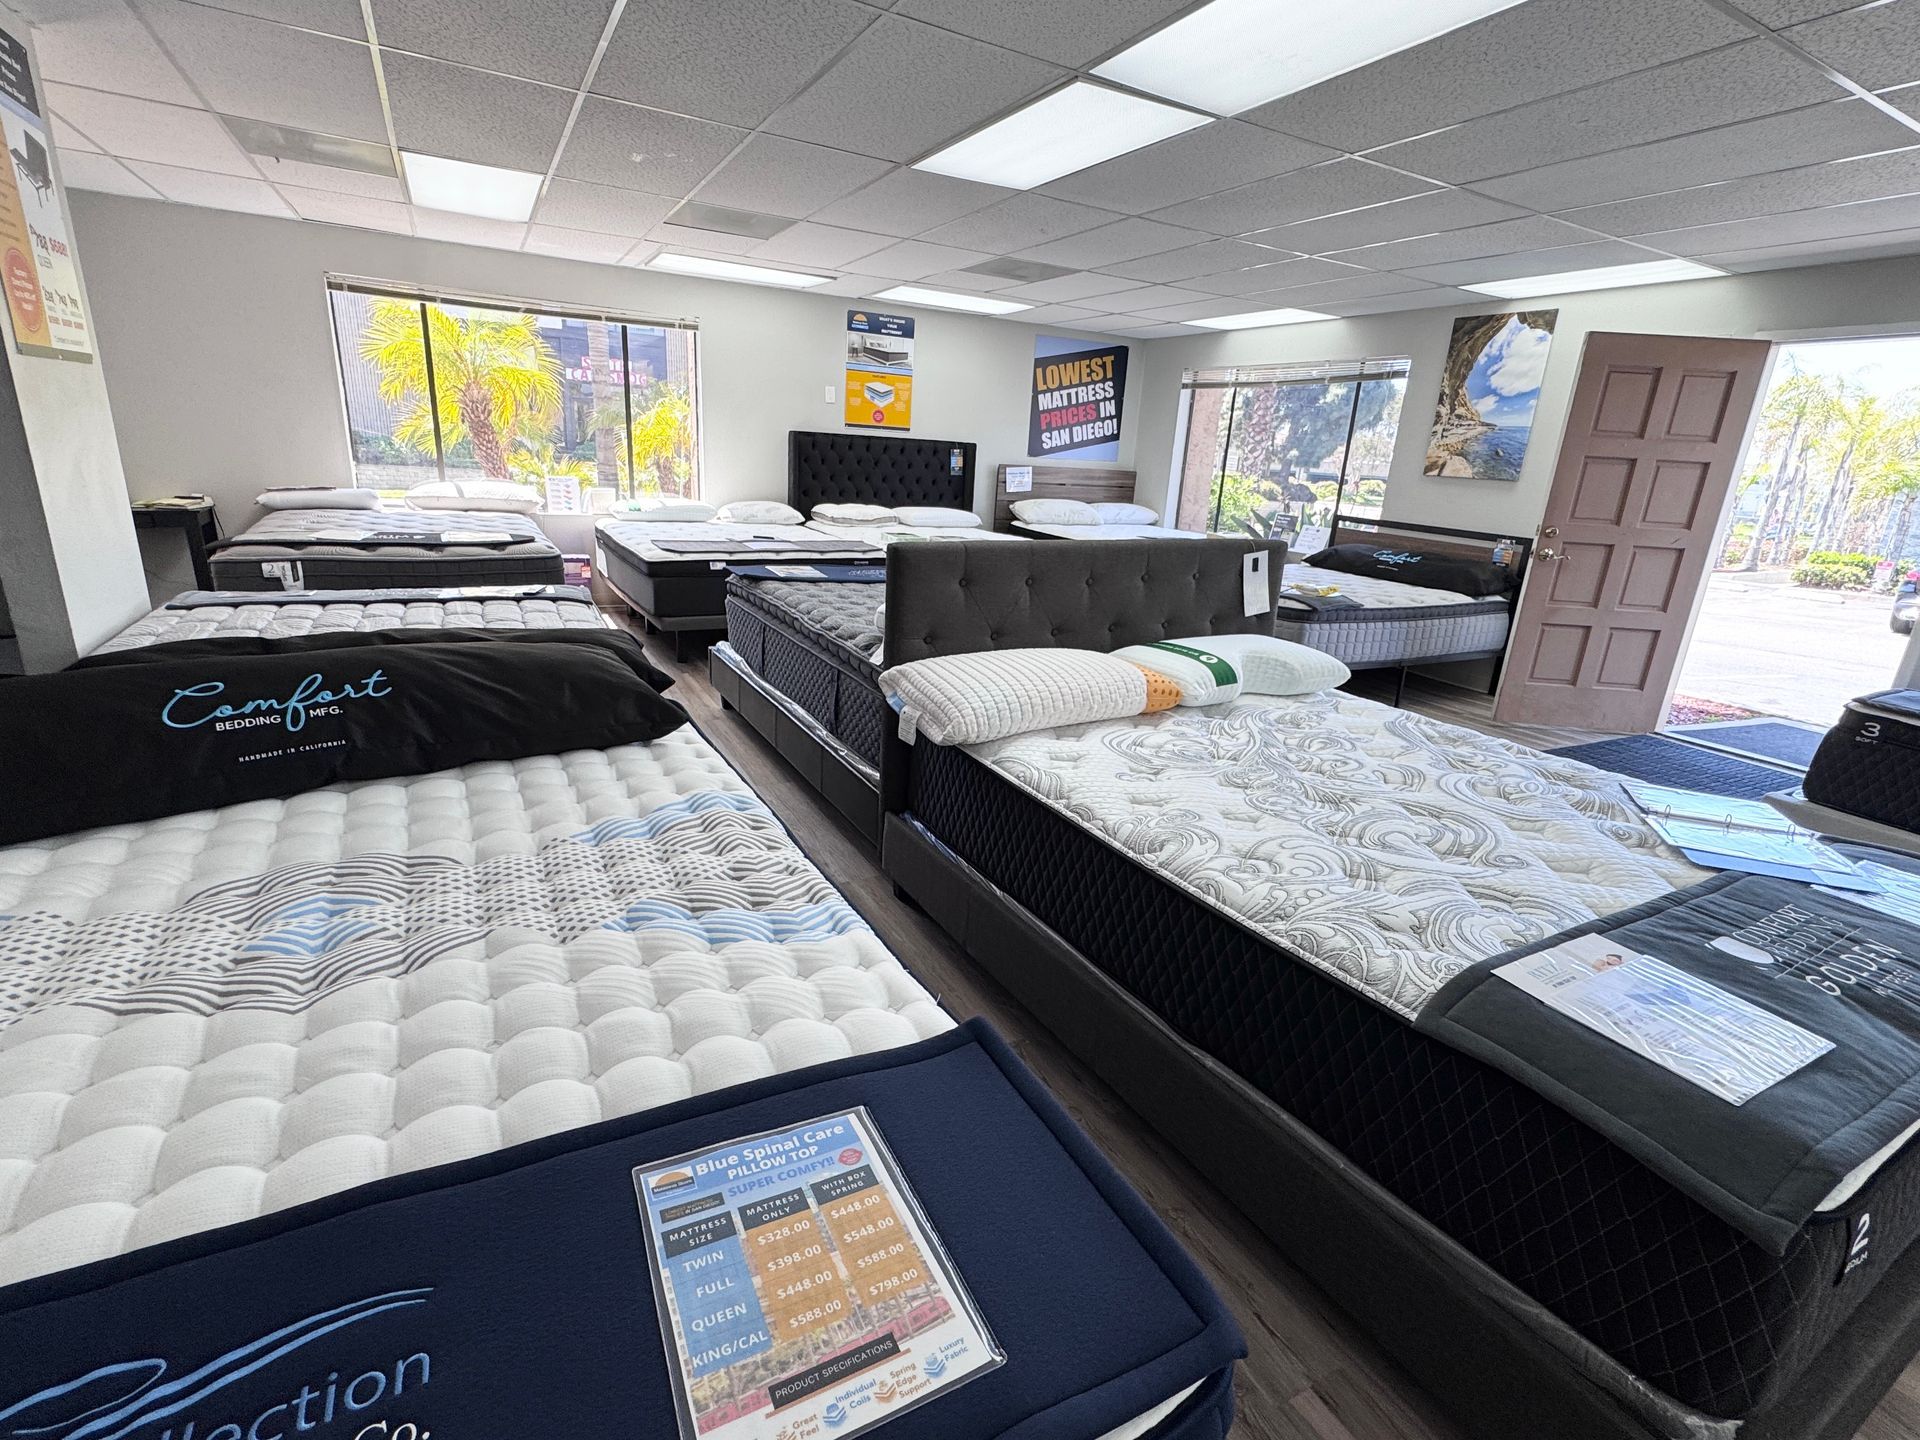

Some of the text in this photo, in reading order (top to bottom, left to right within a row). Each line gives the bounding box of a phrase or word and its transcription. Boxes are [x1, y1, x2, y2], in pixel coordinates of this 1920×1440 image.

[1036, 355, 1115, 391] LOWEST
[1038, 381, 1114, 411] MATTRESS
[1040, 399, 1116, 430] PRICES IN
[1041, 418, 1118, 449] SAN DIEGO!
[162, 669, 393, 732] Comfort
[215, 705, 344, 732] BEDDING MFG.
[1860, 722, 1881, 737] 3
[239, 749, 284, 763] HANDMADE
[299, 739, 347, 752] CALIFORNIA
[1855, 736, 1879, 745] SOFT
[1732, 903, 1815, 946] COMFORT
[1765, 916, 1844, 958] BEDDING
[1806, 937, 1903, 996] GOLDEN
[696, 1125, 845, 1176] Blue Spinal Care
[727, 1154, 787, 1180] PILLOW
[789, 1145, 819, 1162] TOP
[727, 1175, 775, 1198] SUPER
[776, 1155, 836, 1181] COMFY!!
[821, 1170, 867, 1191] WITH BOX
[830, 1180, 864, 1197] SPRING
[746, 1193, 800, 1217] MATTRESS
[762, 1206, 791, 1221] ONLY
[669, 1217, 727, 1242] MATTRESS
[683, 1194, 881, 1273] TWIN $328.00 $448.00
[689, 1232, 713, 1247] SIZE
[1851, 1213, 1870, 1256] 2
[696, 1216, 894, 1298] FULL $398.00 $548.00
[691, 1243, 905, 1332] QUEEN $448.00 $588.00
[692, 1268, 918, 1368] KING/CAL $588.00 $798.00
[939, 1336, 966, 1354] Luxury
[945, 1345, 969, 1362] Fabric
[775, 1340, 893, 1399] PRODUCT SPECIFICATIONS
[889, 1362, 917, 1380] Spring
[895, 1373, 918, 1389] Edge
[835, 1378, 877, 1404] Individual
[899, 1378, 933, 1399] Support
[849, 1394, 872, 1410] Coils
[792, 1413, 819, 1430] Great
[800, 1424, 820, 1439] Feel
